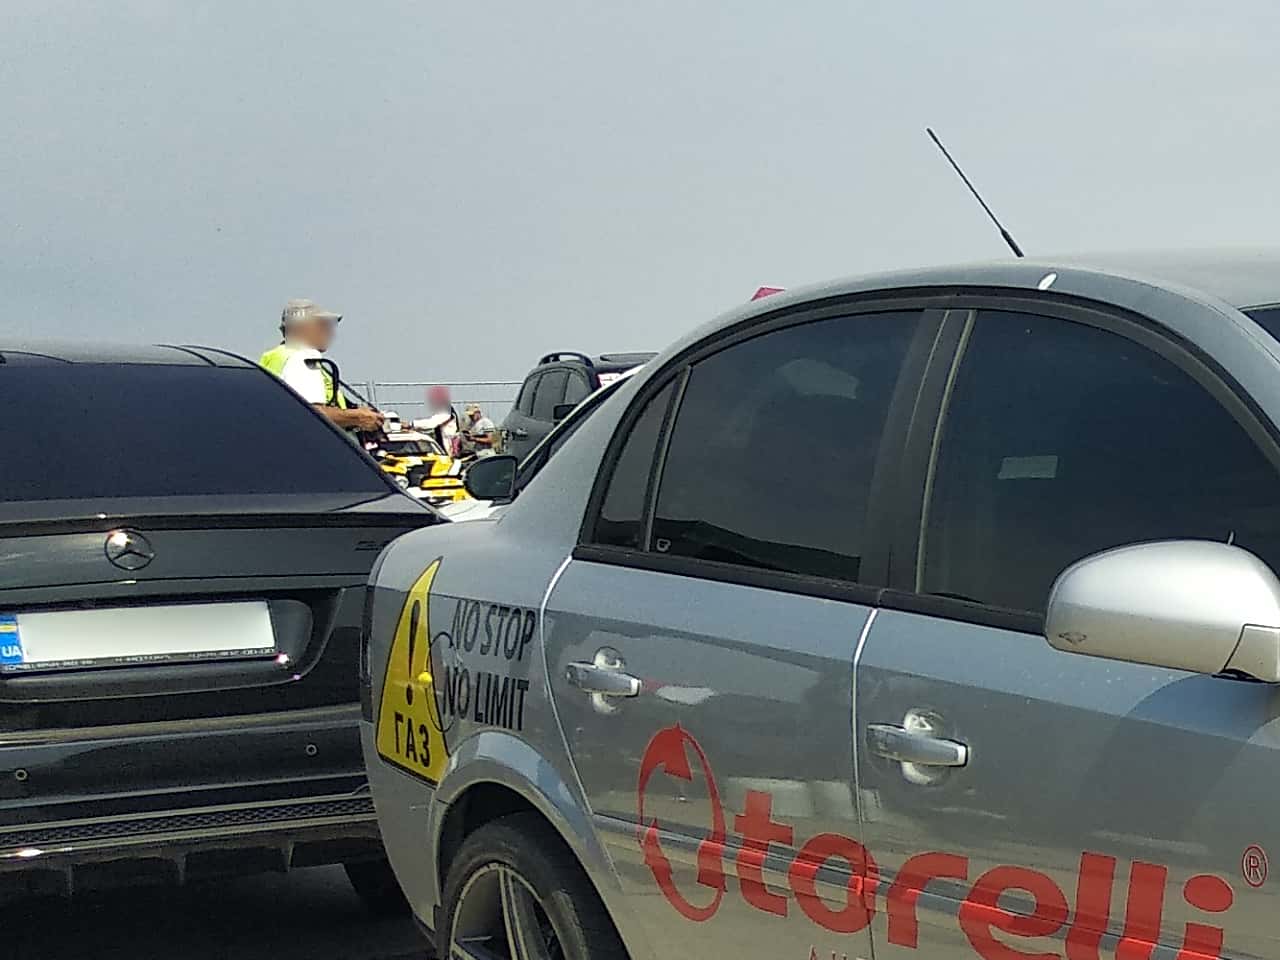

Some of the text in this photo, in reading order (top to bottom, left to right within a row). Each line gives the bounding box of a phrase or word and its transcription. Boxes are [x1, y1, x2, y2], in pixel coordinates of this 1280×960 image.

[1, 645, 23, 658] UA
[450, 599, 536, 662] NO STOP
[443, 667, 530, 732] NO LIMIT
[393, 711, 431, 768] ГАЗ
